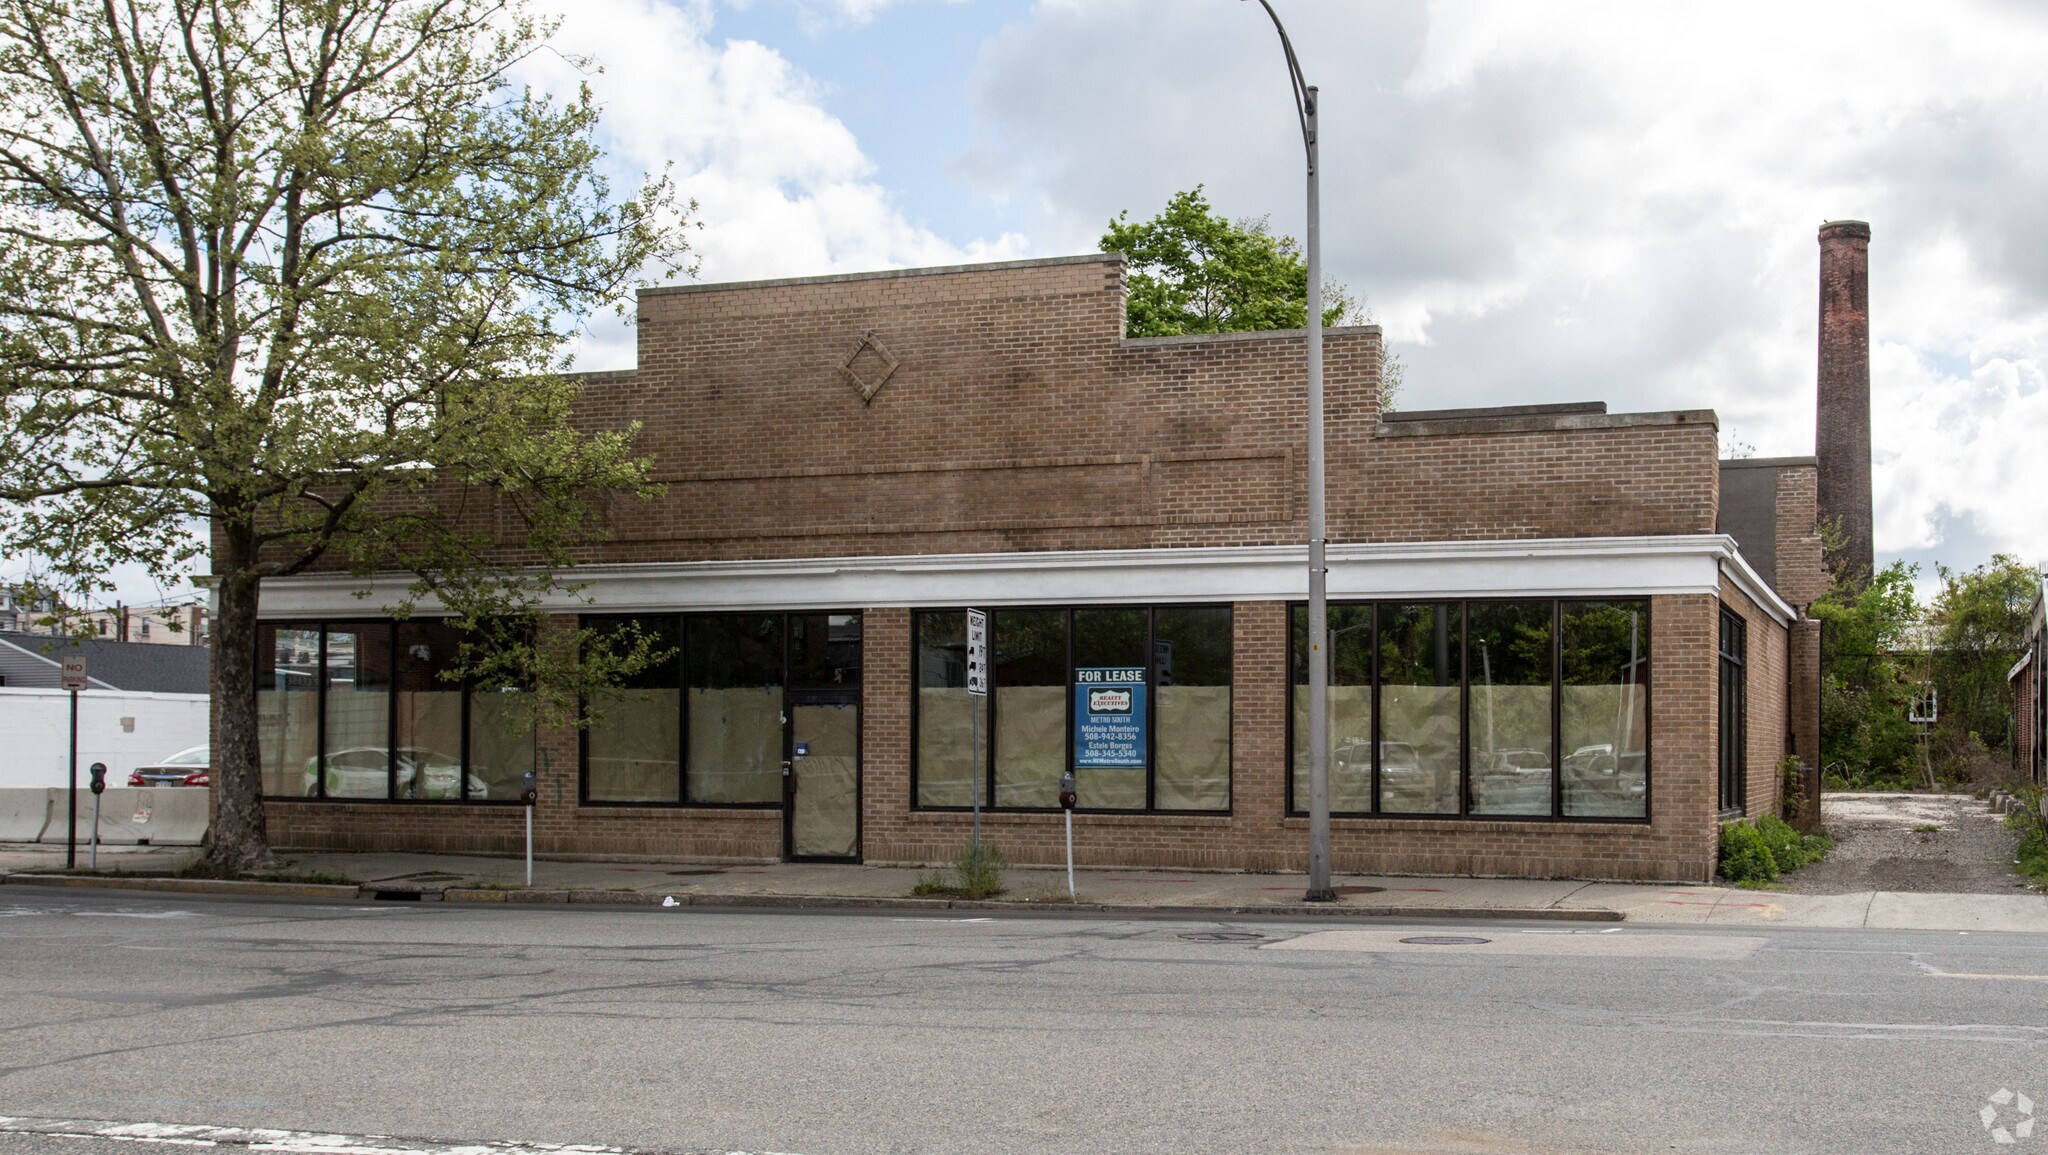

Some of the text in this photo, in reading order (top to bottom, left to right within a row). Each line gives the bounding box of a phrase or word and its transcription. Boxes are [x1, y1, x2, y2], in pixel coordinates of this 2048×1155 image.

[970, 615, 984, 628] WEIGHT
[971, 629, 982, 641] LIMIT
[66, 663, 83, 671] NO
[1078, 670, 1142, 682] FOR LEASE
[1084, 732, 1137, 740] 508-942-8356
[1109, 741, 1133, 749] Borges
[1084, 749, 1137, 757] 508-345-5340
